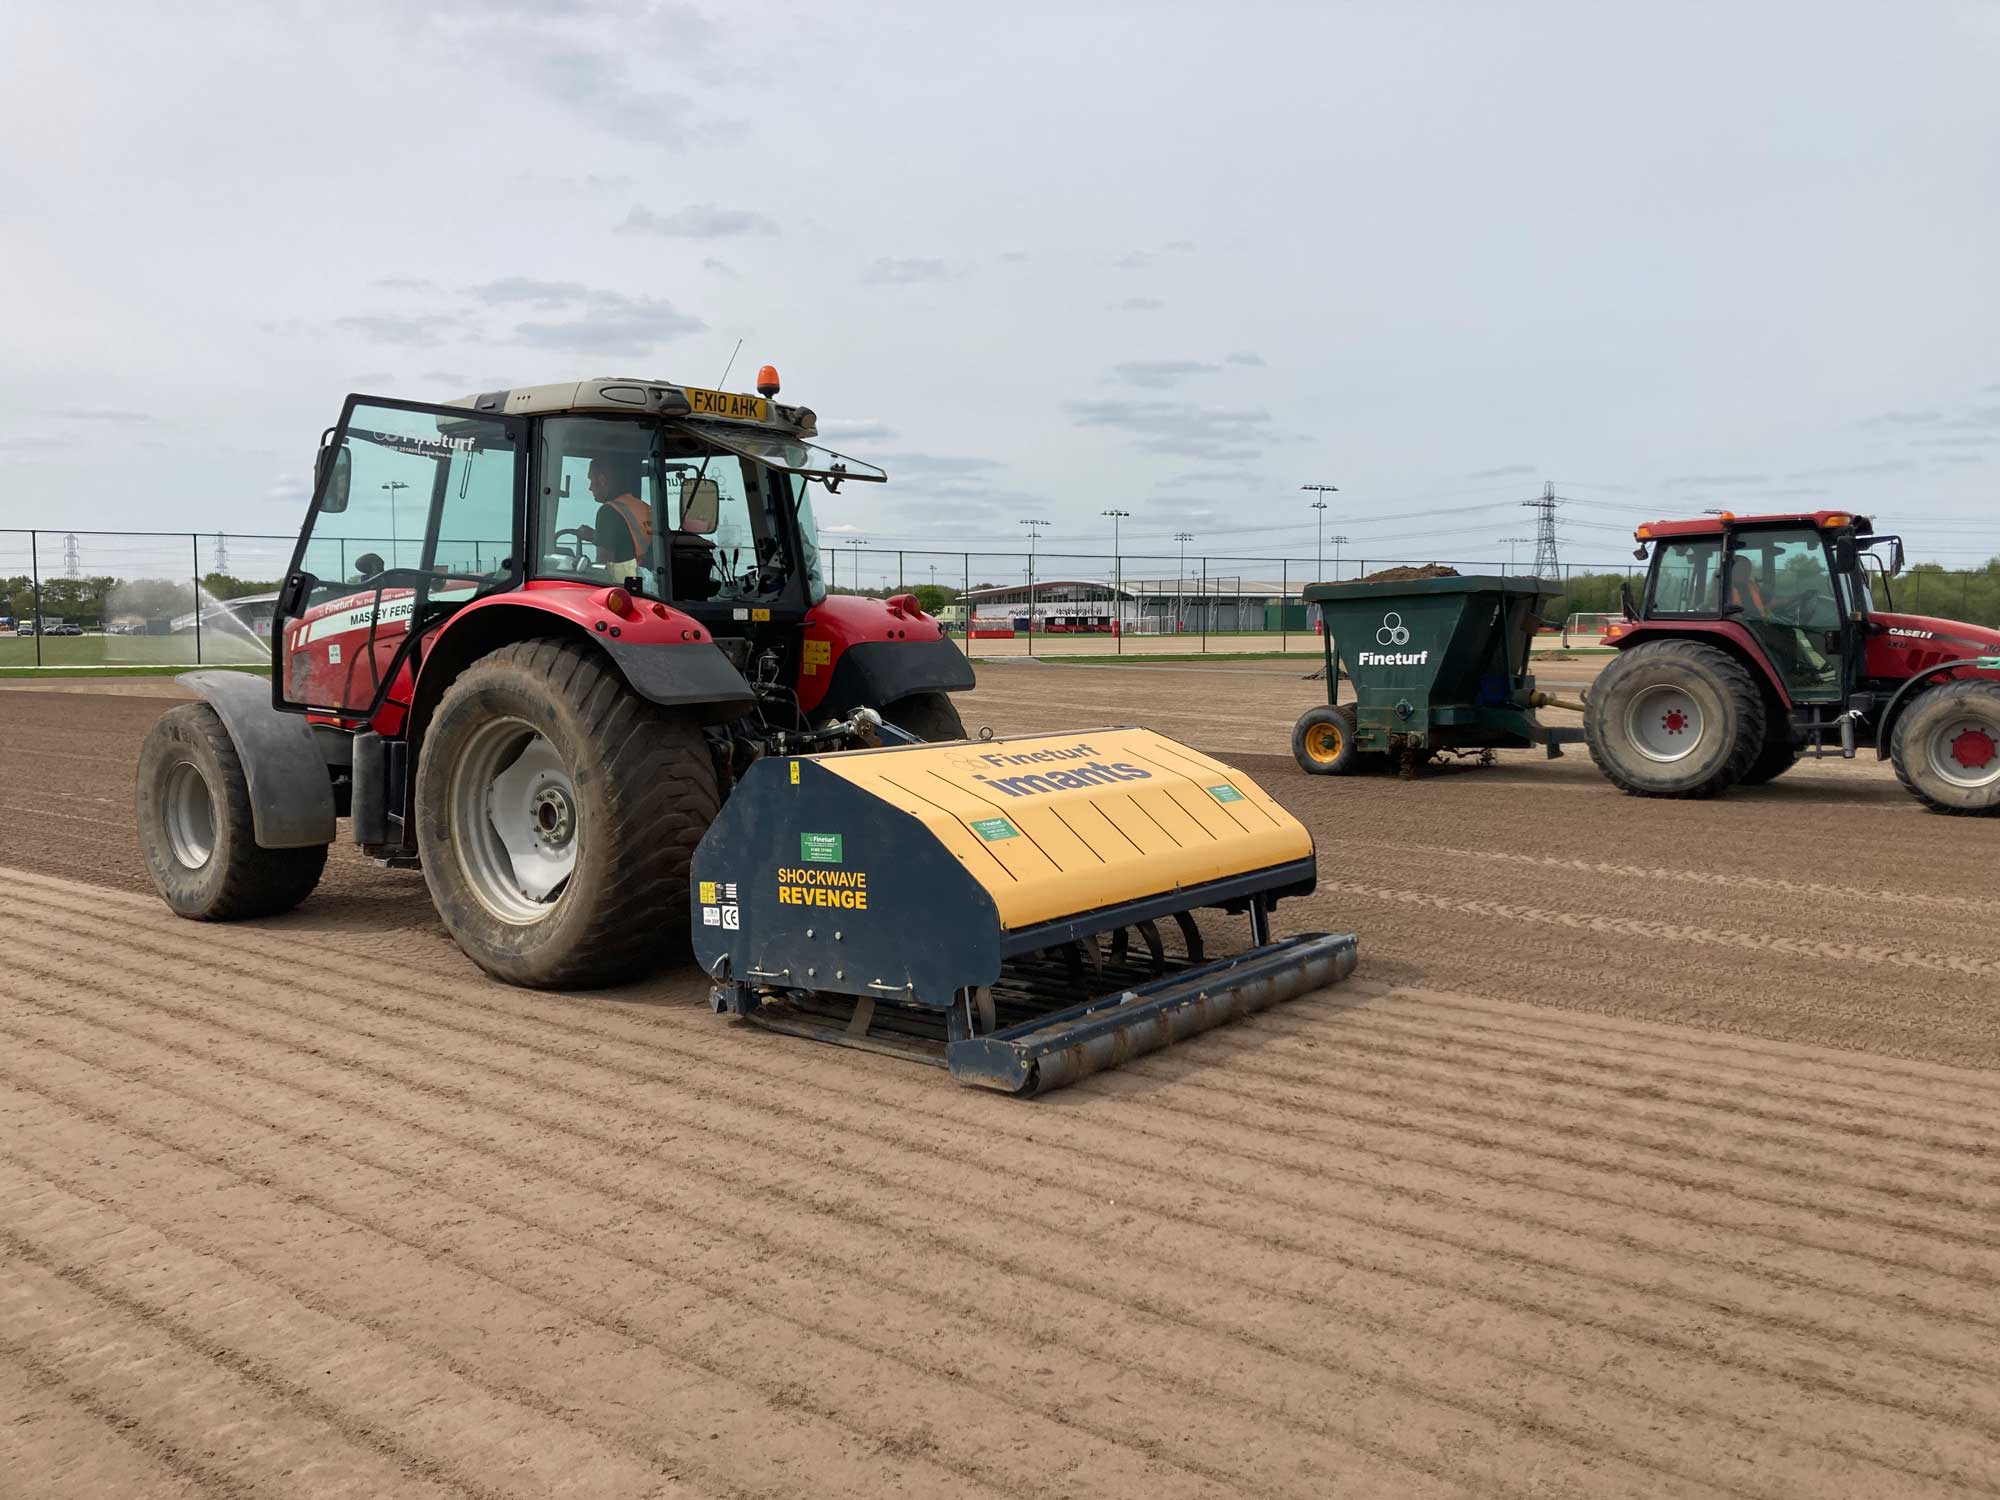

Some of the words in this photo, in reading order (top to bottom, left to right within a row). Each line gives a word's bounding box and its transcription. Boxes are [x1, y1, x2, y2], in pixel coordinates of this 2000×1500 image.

[694, 391, 727, 413] FX10
[731, 397, 758, 418] AHK
[324, 598, 354, 614] Fineturf
[350, 608, 388, 626] MASEY
[1358, 650, 1429, 666] Fineturf
[979, 743, 1101, 768] Fineturf
[972, 761, 1152, 797] imants
[778, 867, 867, 889] SHOCKWAVE
[778, 885, 868, 910] REVENGE
[724, 909, 738, 926] CE
